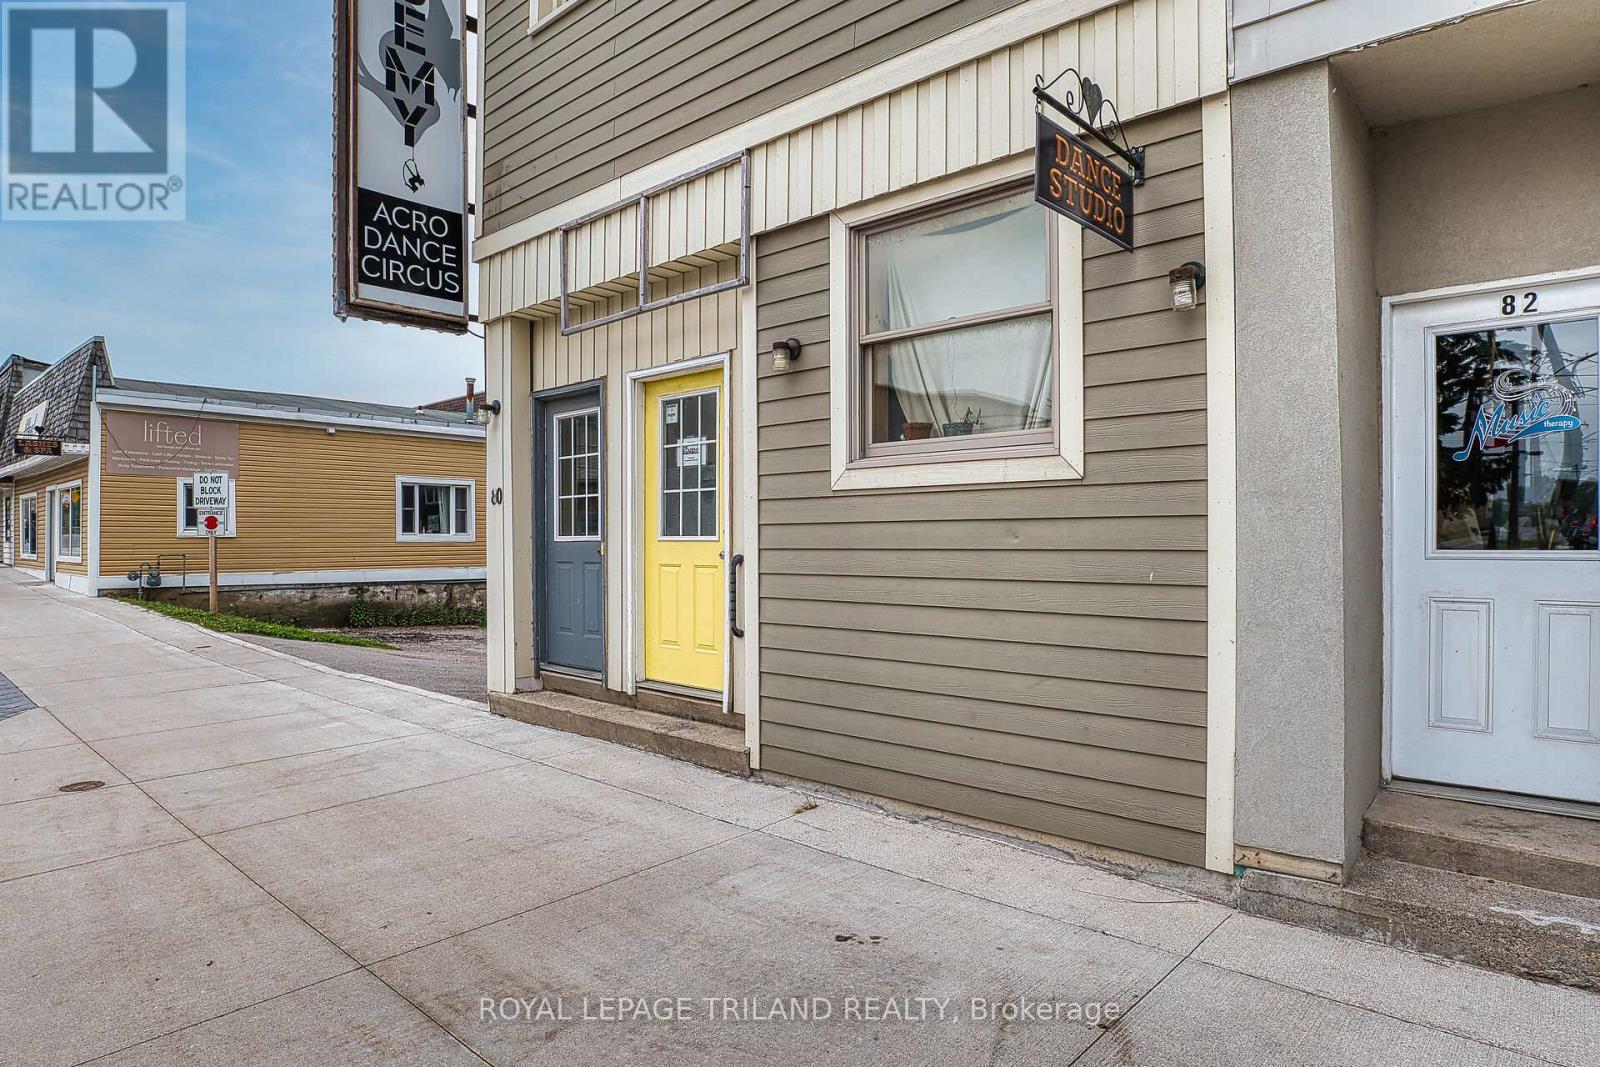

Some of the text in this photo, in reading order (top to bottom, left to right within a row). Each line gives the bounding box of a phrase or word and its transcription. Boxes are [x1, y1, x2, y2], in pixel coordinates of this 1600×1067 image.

[385, 0, 435, 147] EMY
[1055, 134, 1121, 201] DANCE
[1049, 168, 1125, 234] STUDIO
[372, 201, 449, 238] ACRO
[364, 226, 457, 267] DANCE
[361, 255, 460, 294] CIRCUS
[1501, 292, 1538, 316] 82
[144, 420, 201, 446] lifted
[1452, 393, 1551, 461] Music
[1543, 418, 1573, 429] therapy
[17, 440, 58, 448] LASHES
[199, 475, 223, 484] DO NOT
[200, 487, 222, 495] BLOCK
[195, 497, 226, 506] DRIVEWAY
